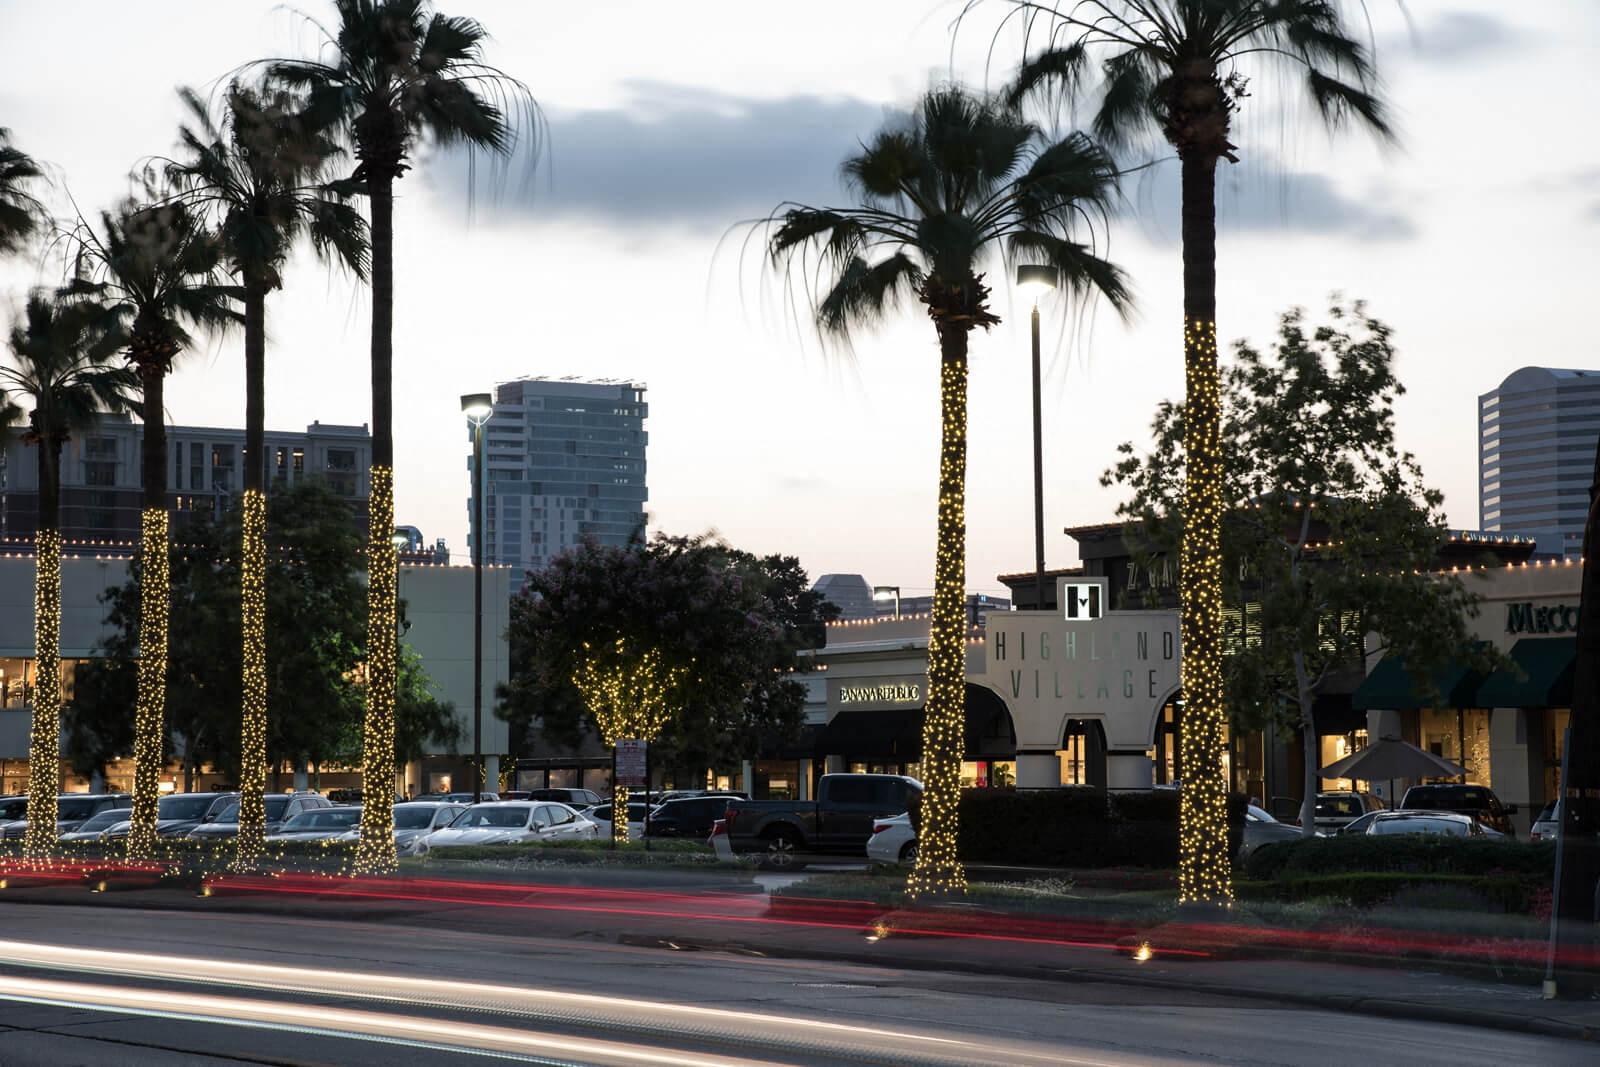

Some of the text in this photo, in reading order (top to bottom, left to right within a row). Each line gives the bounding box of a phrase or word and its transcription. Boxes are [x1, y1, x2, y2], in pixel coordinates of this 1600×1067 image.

[995, 631, 1173, 661] HIGHLAND
[840, 683, 918, 701] BANANA REPUBLIC
[1010, 669, 1157, 699] VILLAGE
